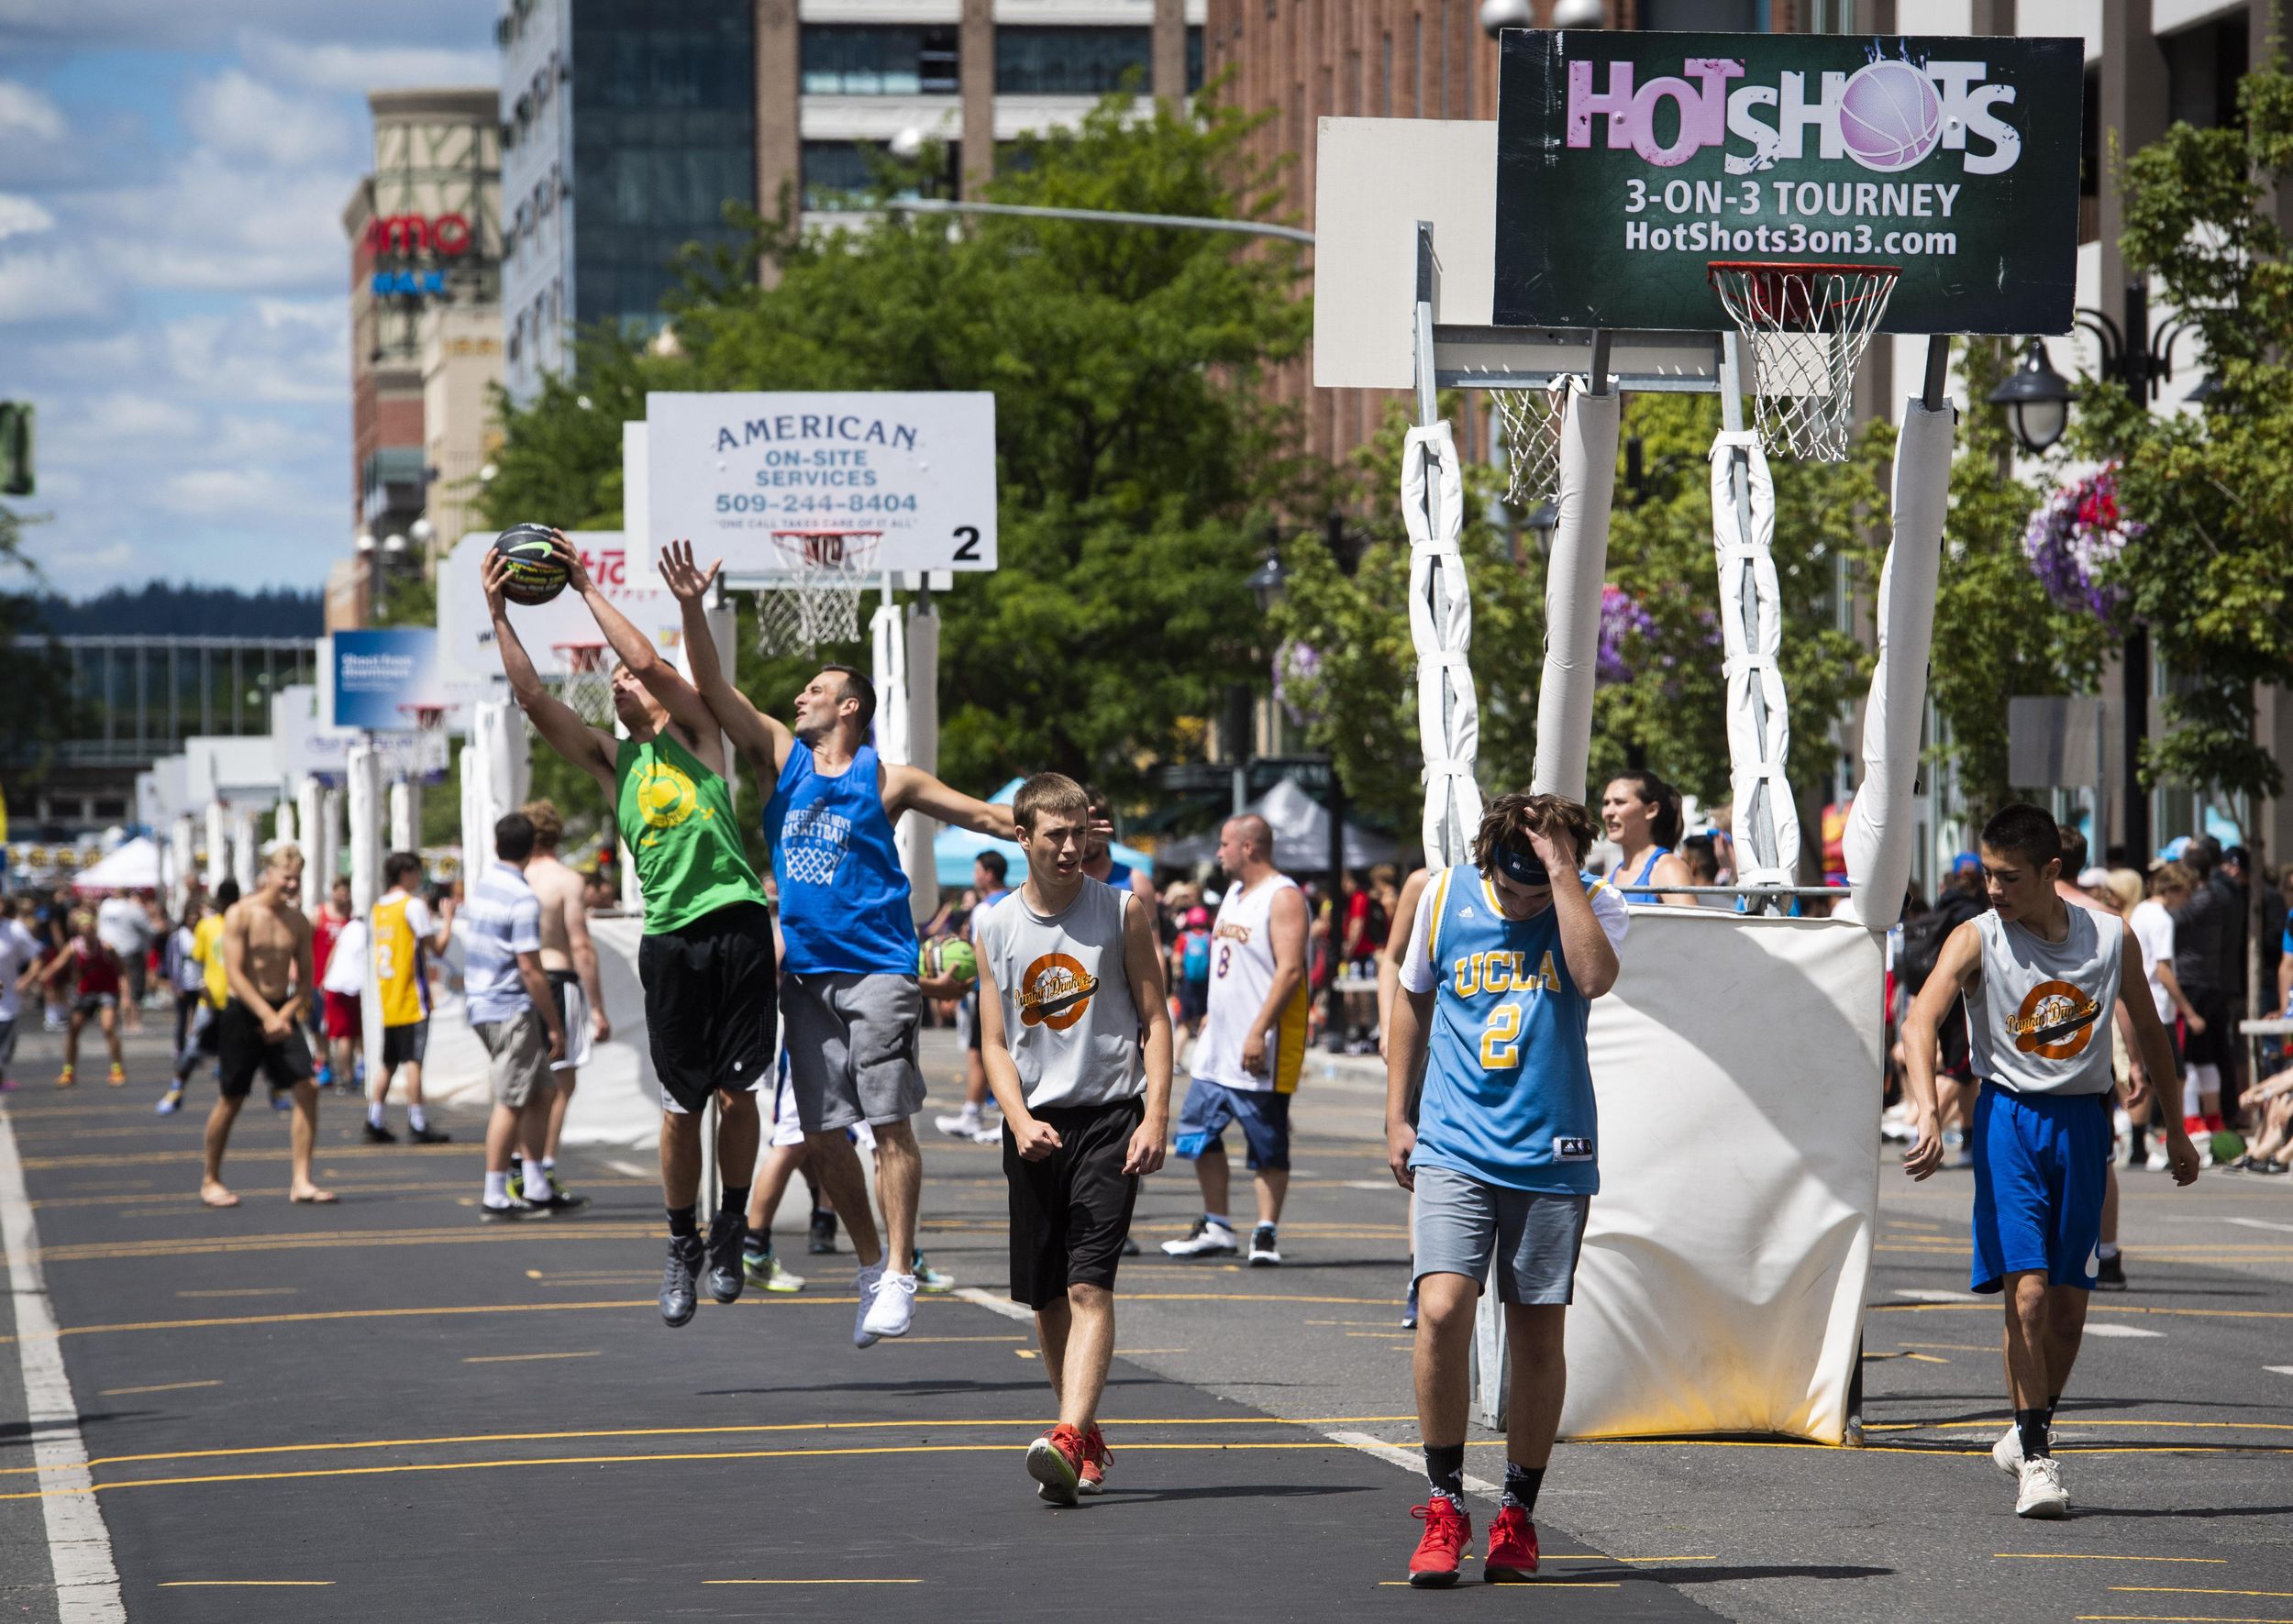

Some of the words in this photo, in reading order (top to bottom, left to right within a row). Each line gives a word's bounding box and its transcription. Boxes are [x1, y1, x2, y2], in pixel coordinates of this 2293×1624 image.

[1625, 179, 1762, 215] 3-ON-3
[1773, 181, 1961, 218] TOURNEY
[1624, 220, 1957, 256] HotShots3on3.com
[716, 414, 918, 453] AMERICAN
[765, 449, 868, 468] ON-SITE
[756, 470, 878, 487] SERVICES
[715, 493, 917, 514] 509-244-8404
[952, 526, 981, 561] 2
[1217, 945, 1231, 978] 8
[1455, 949, 1561, 999] UCLA
[1479, 1002, 1523, 1070] 2
